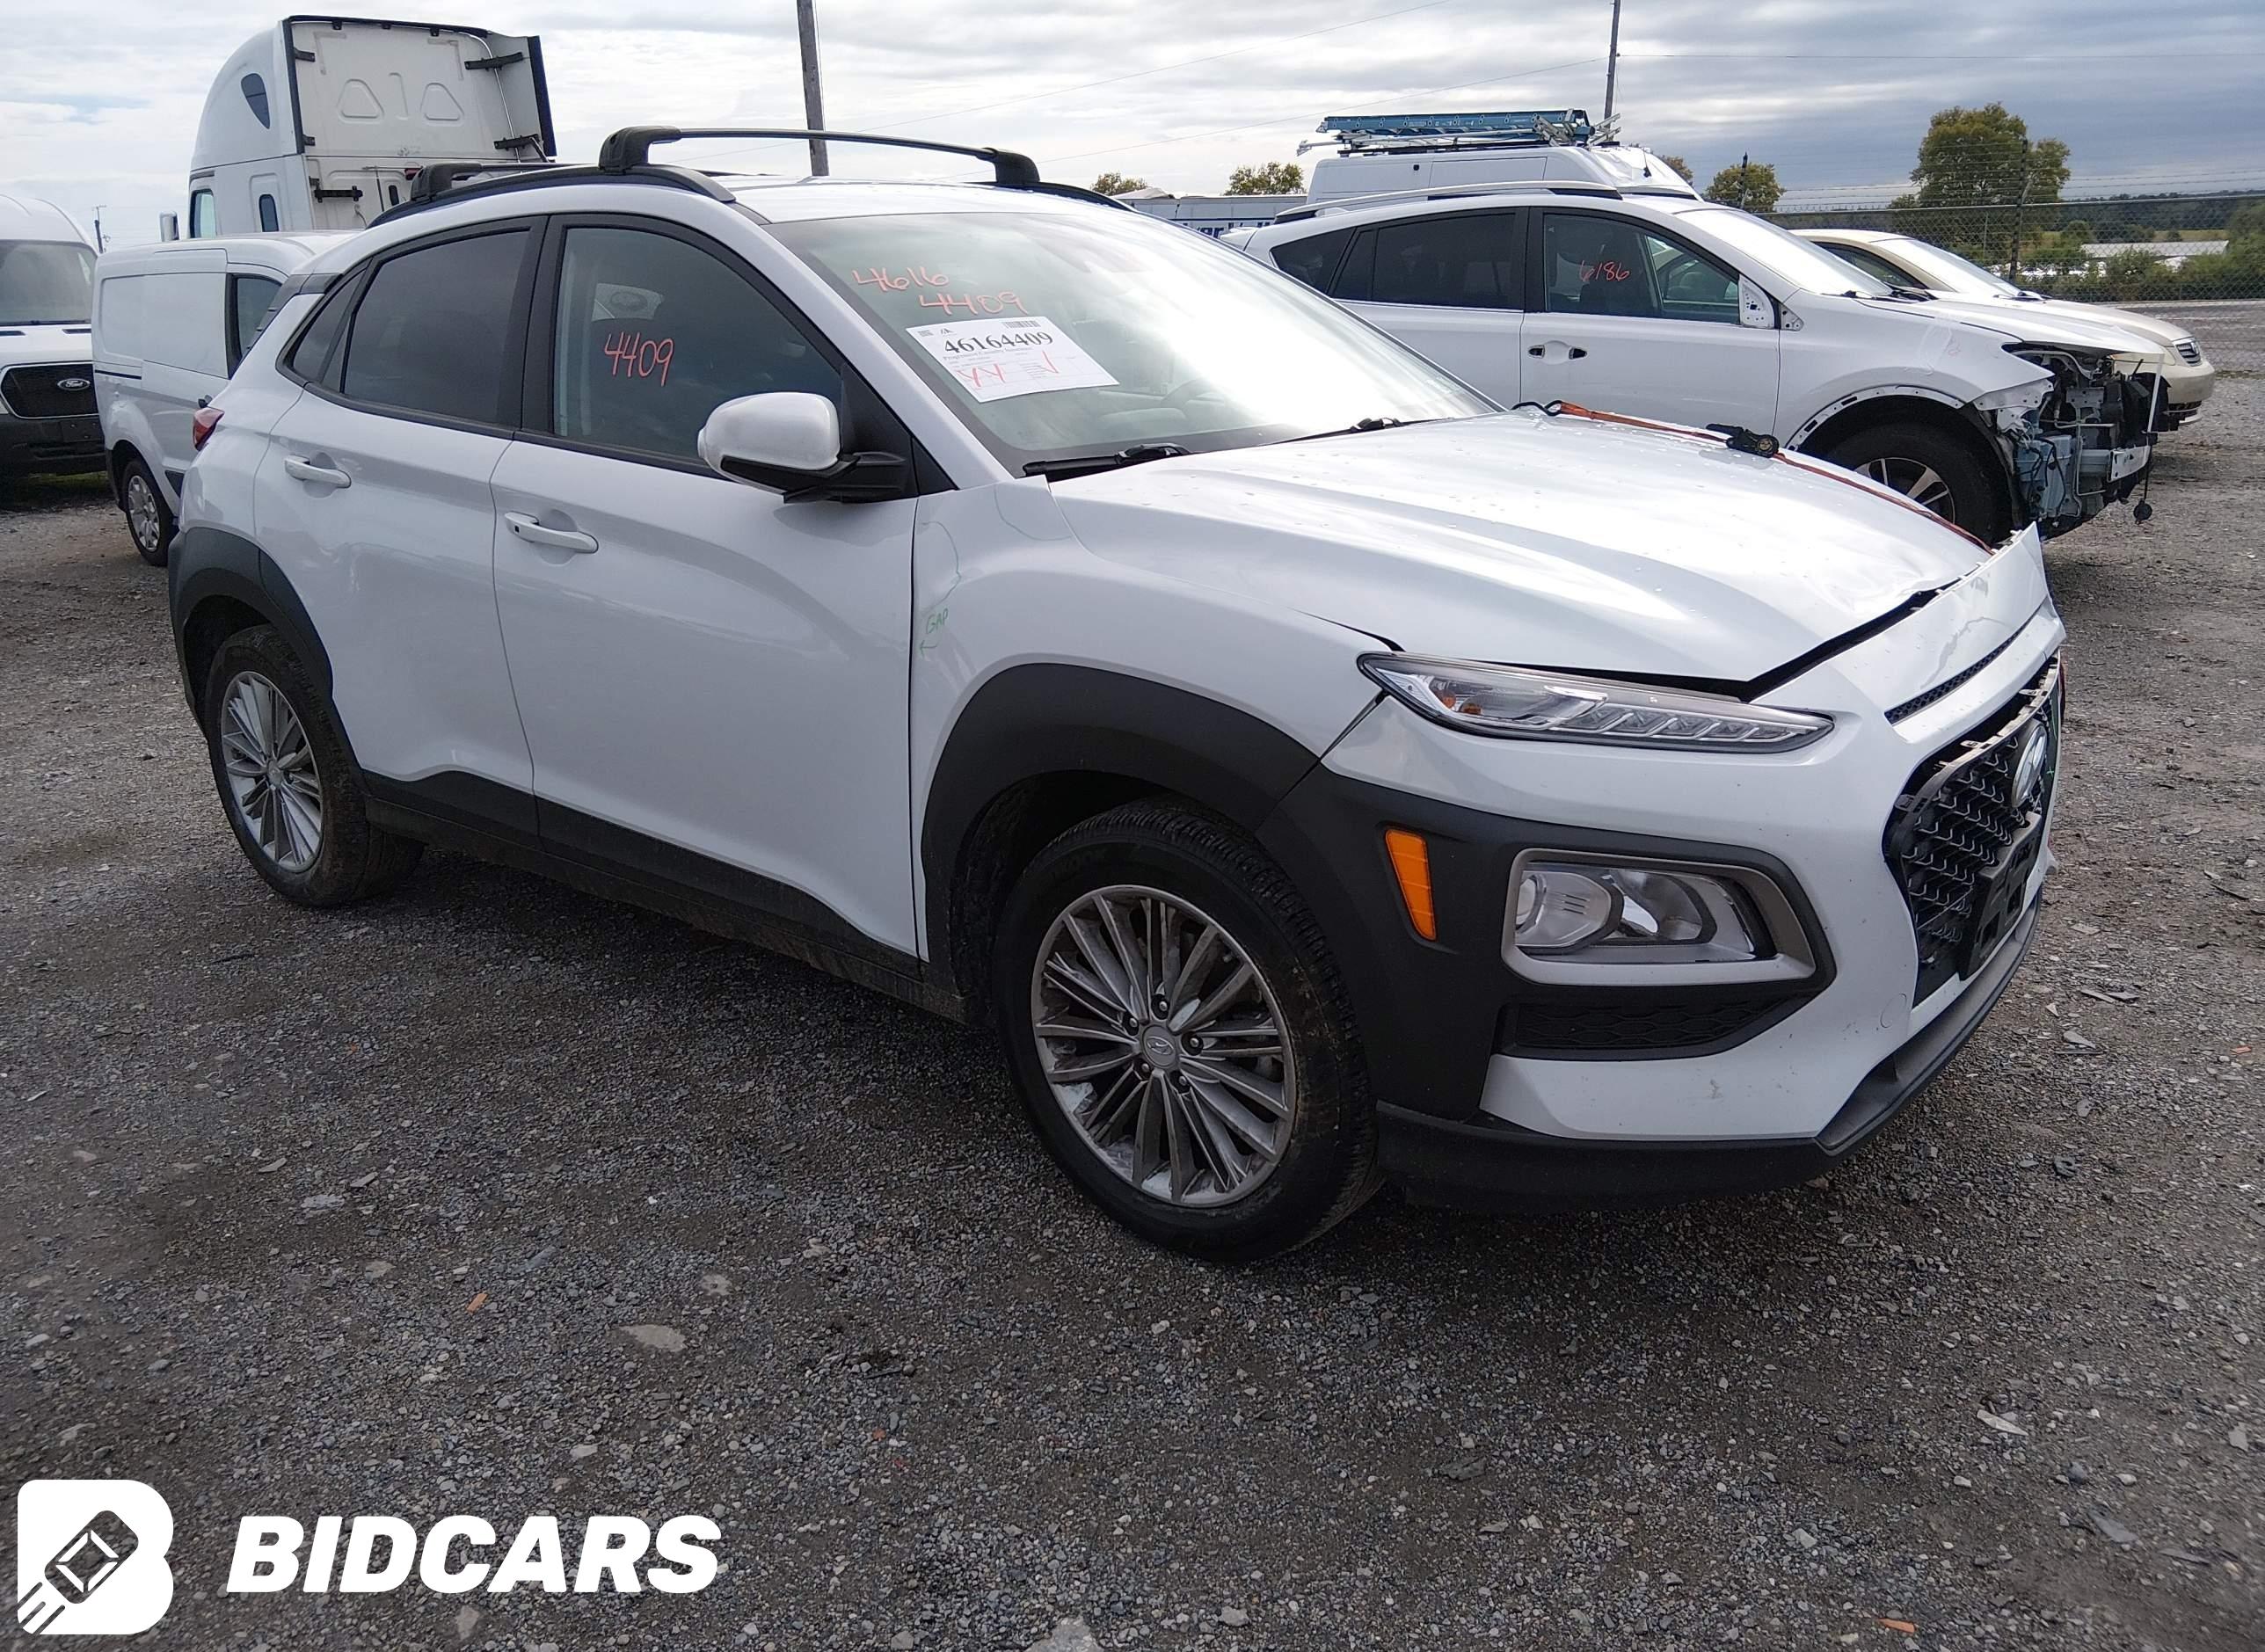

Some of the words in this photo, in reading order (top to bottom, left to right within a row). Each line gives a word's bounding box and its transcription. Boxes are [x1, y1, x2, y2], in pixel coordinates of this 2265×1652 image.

[852, 266, 949, 292] 4616
[1579, 260, 1630, 281] 6186
[919, 291, 1028, 315] 4409
[944, 331, 1053, 353] 46164409
[605, 331, 674, 387] 4409
